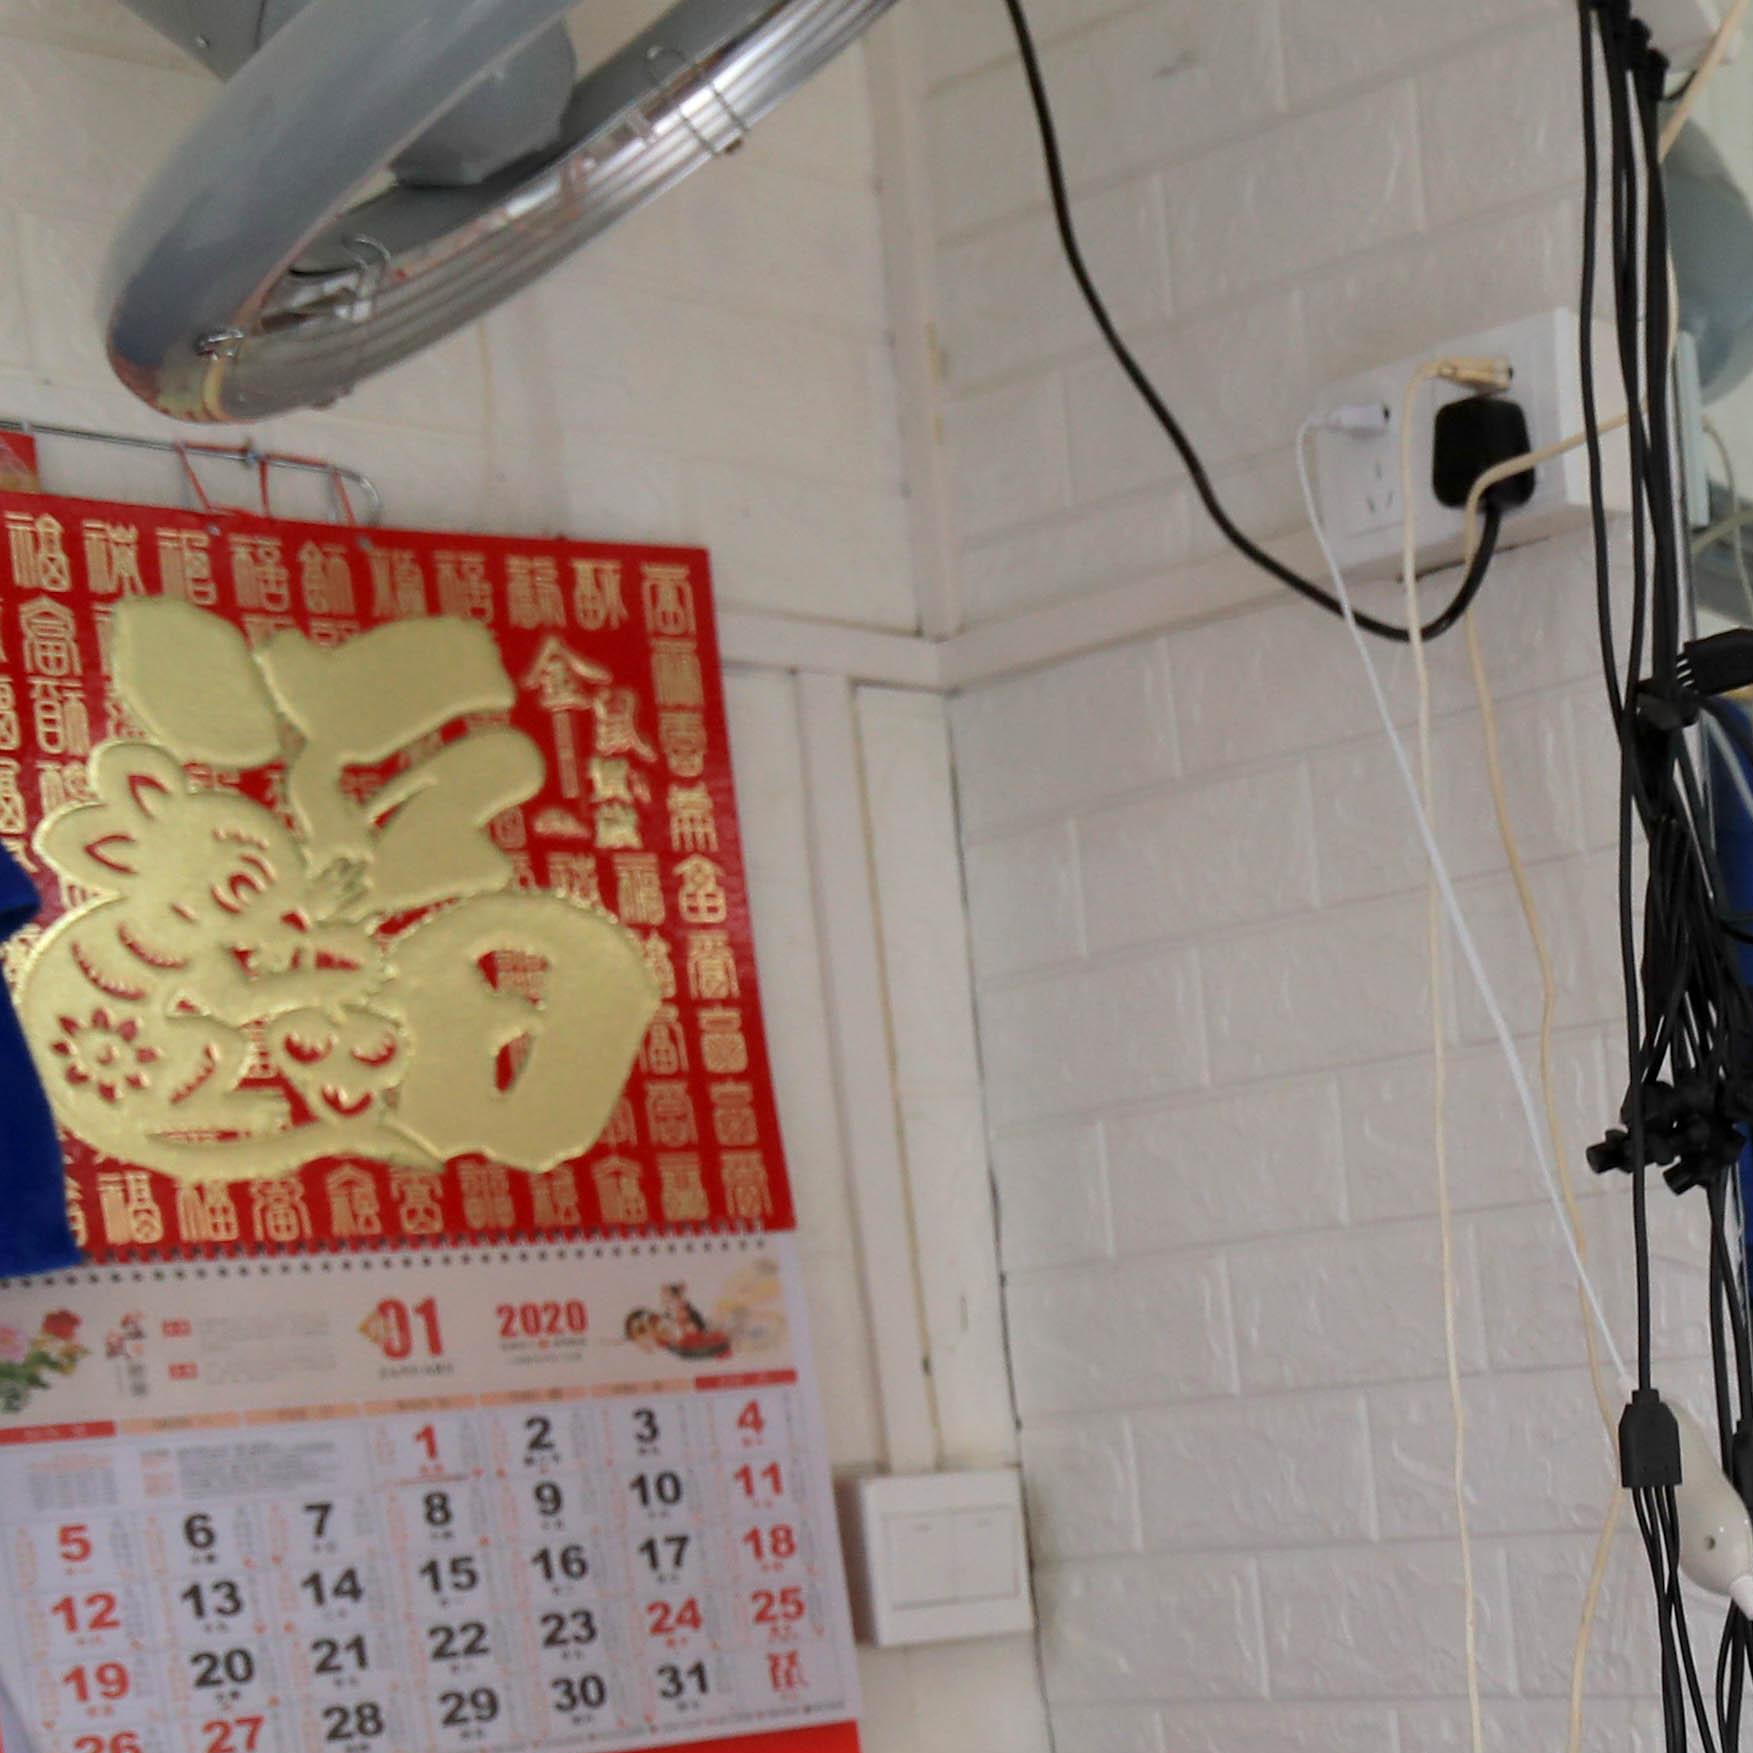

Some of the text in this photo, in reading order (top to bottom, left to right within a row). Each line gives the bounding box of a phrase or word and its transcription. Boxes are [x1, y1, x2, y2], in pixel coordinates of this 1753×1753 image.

[375, 1295, 444, 1361] 01
[495, 1297, 591, 1340] 2020
[414, 1400, 764, 1458] 1 2 3 4
[58, 1462, 783, 1563] 5 6 7 8 9 10 11
[53, 1524, 798, 1634] 12 13 14 15 16 17 18
[63, 1585, 806, 1703] 19 20 21 22 23 24 25
[321, 1700, 385, 1743] 28
[438, 1686, 501, 1728] 29
[550, 1672, 608, 1714] 30
[656, 1659, 710, 1700] 31
